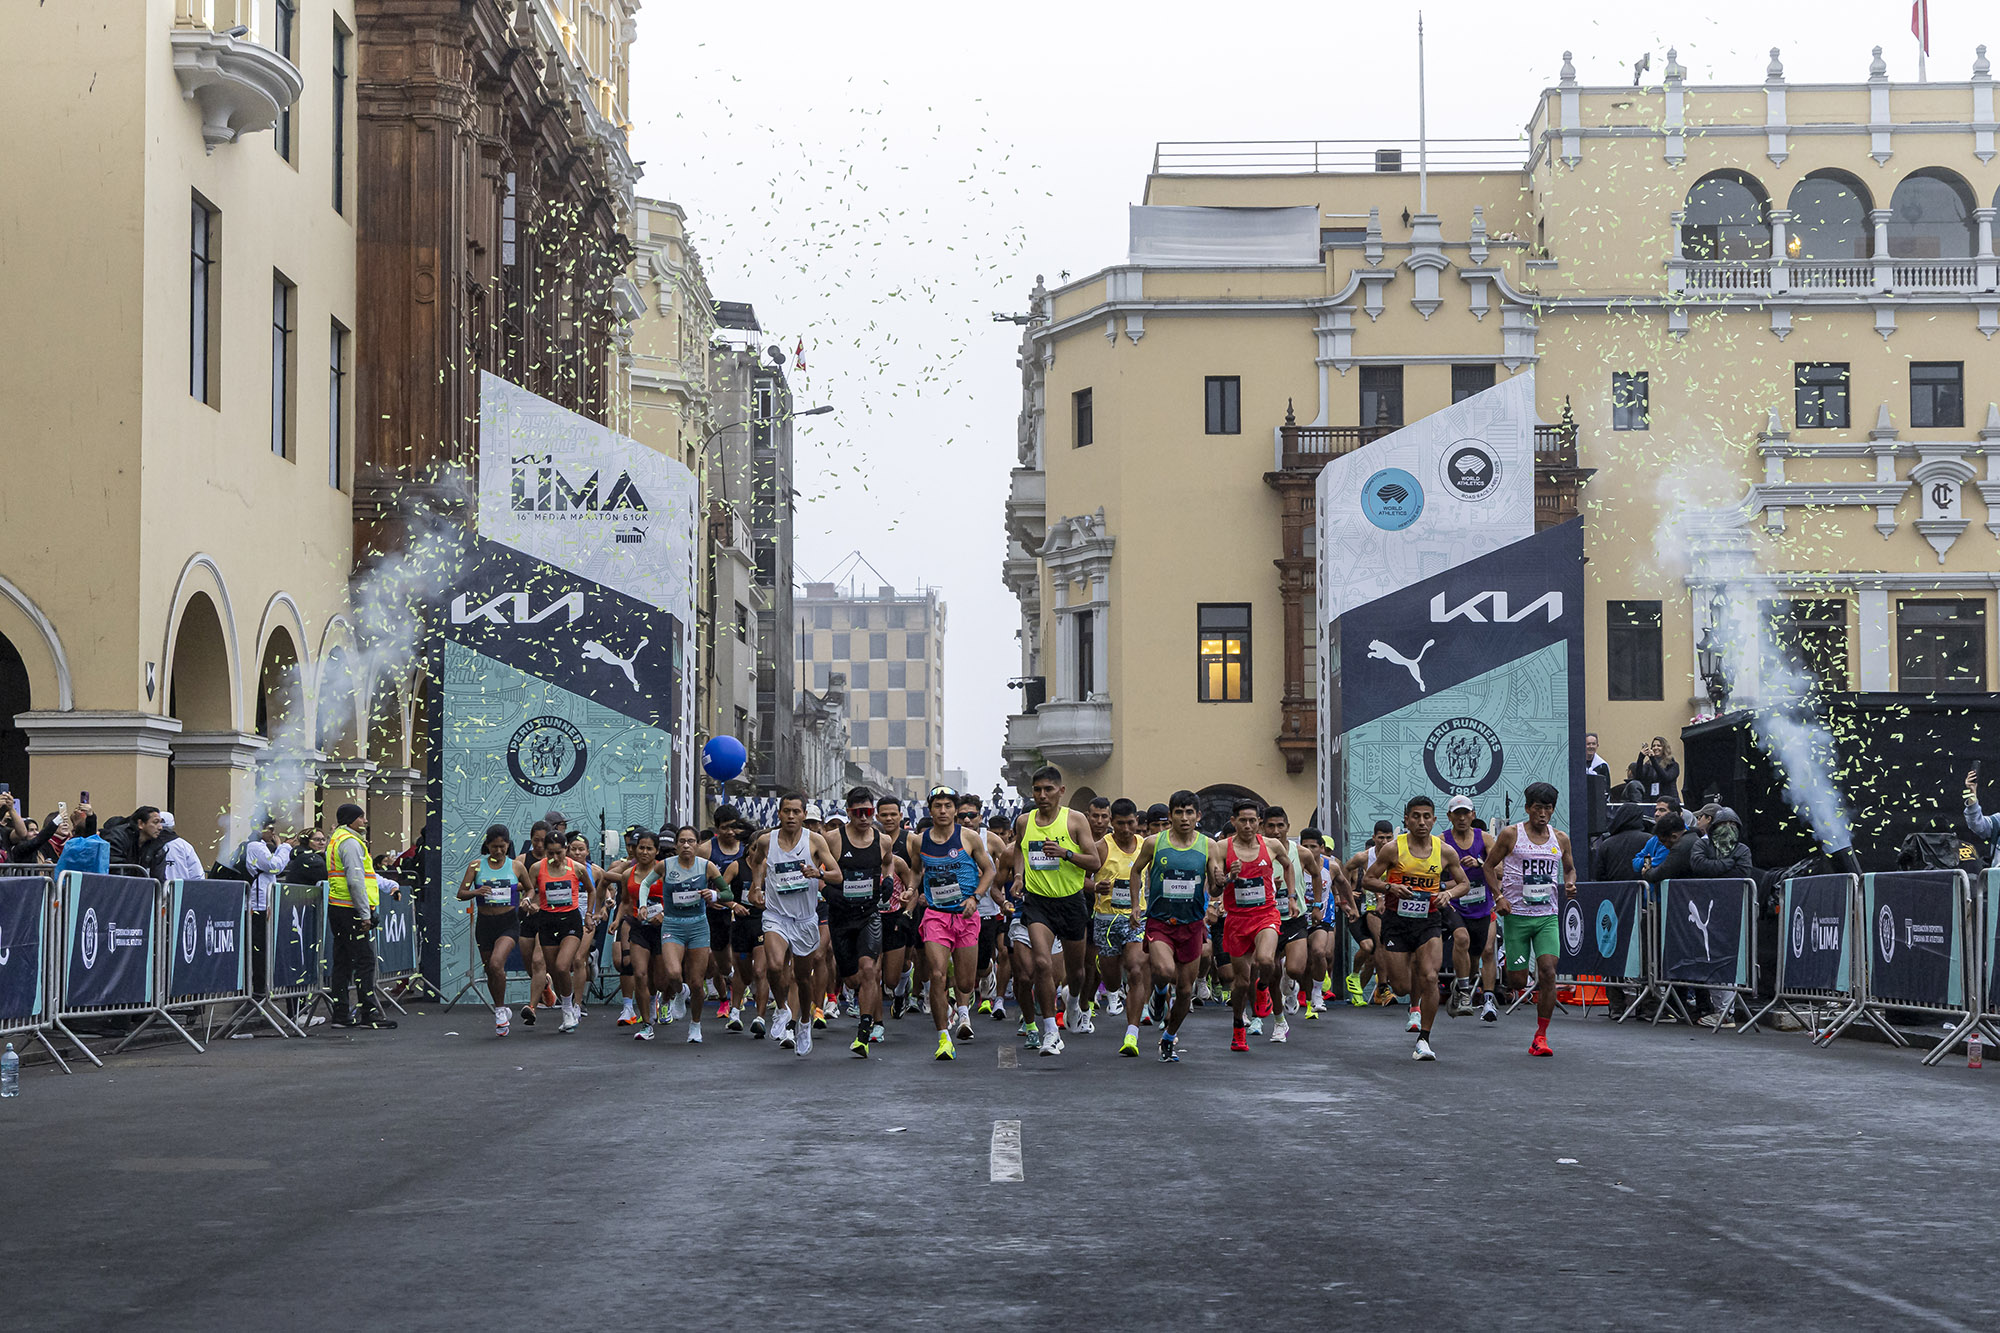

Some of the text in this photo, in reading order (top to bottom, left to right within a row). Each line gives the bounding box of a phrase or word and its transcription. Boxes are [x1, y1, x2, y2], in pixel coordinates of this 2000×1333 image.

[511, 468, 648, 511] LIMA
[615, 534, 642, 543] PUMA
[510, 717, 585, 751] PERU RUNNERS
[1426, 719, 1501, 752] PERU RUNNERS
[532, 784, 560, 795] 1984
[1449, 786, 1477, 796] 1984
[1522, 859, 1554, 875] PERU
[1402, 875, 1434, 888] PERU
[1401, 901, 1427, 912] 9225
[214, 929, 234, 953] LIMA
[1819, 926, 1839, 950] LIMA
